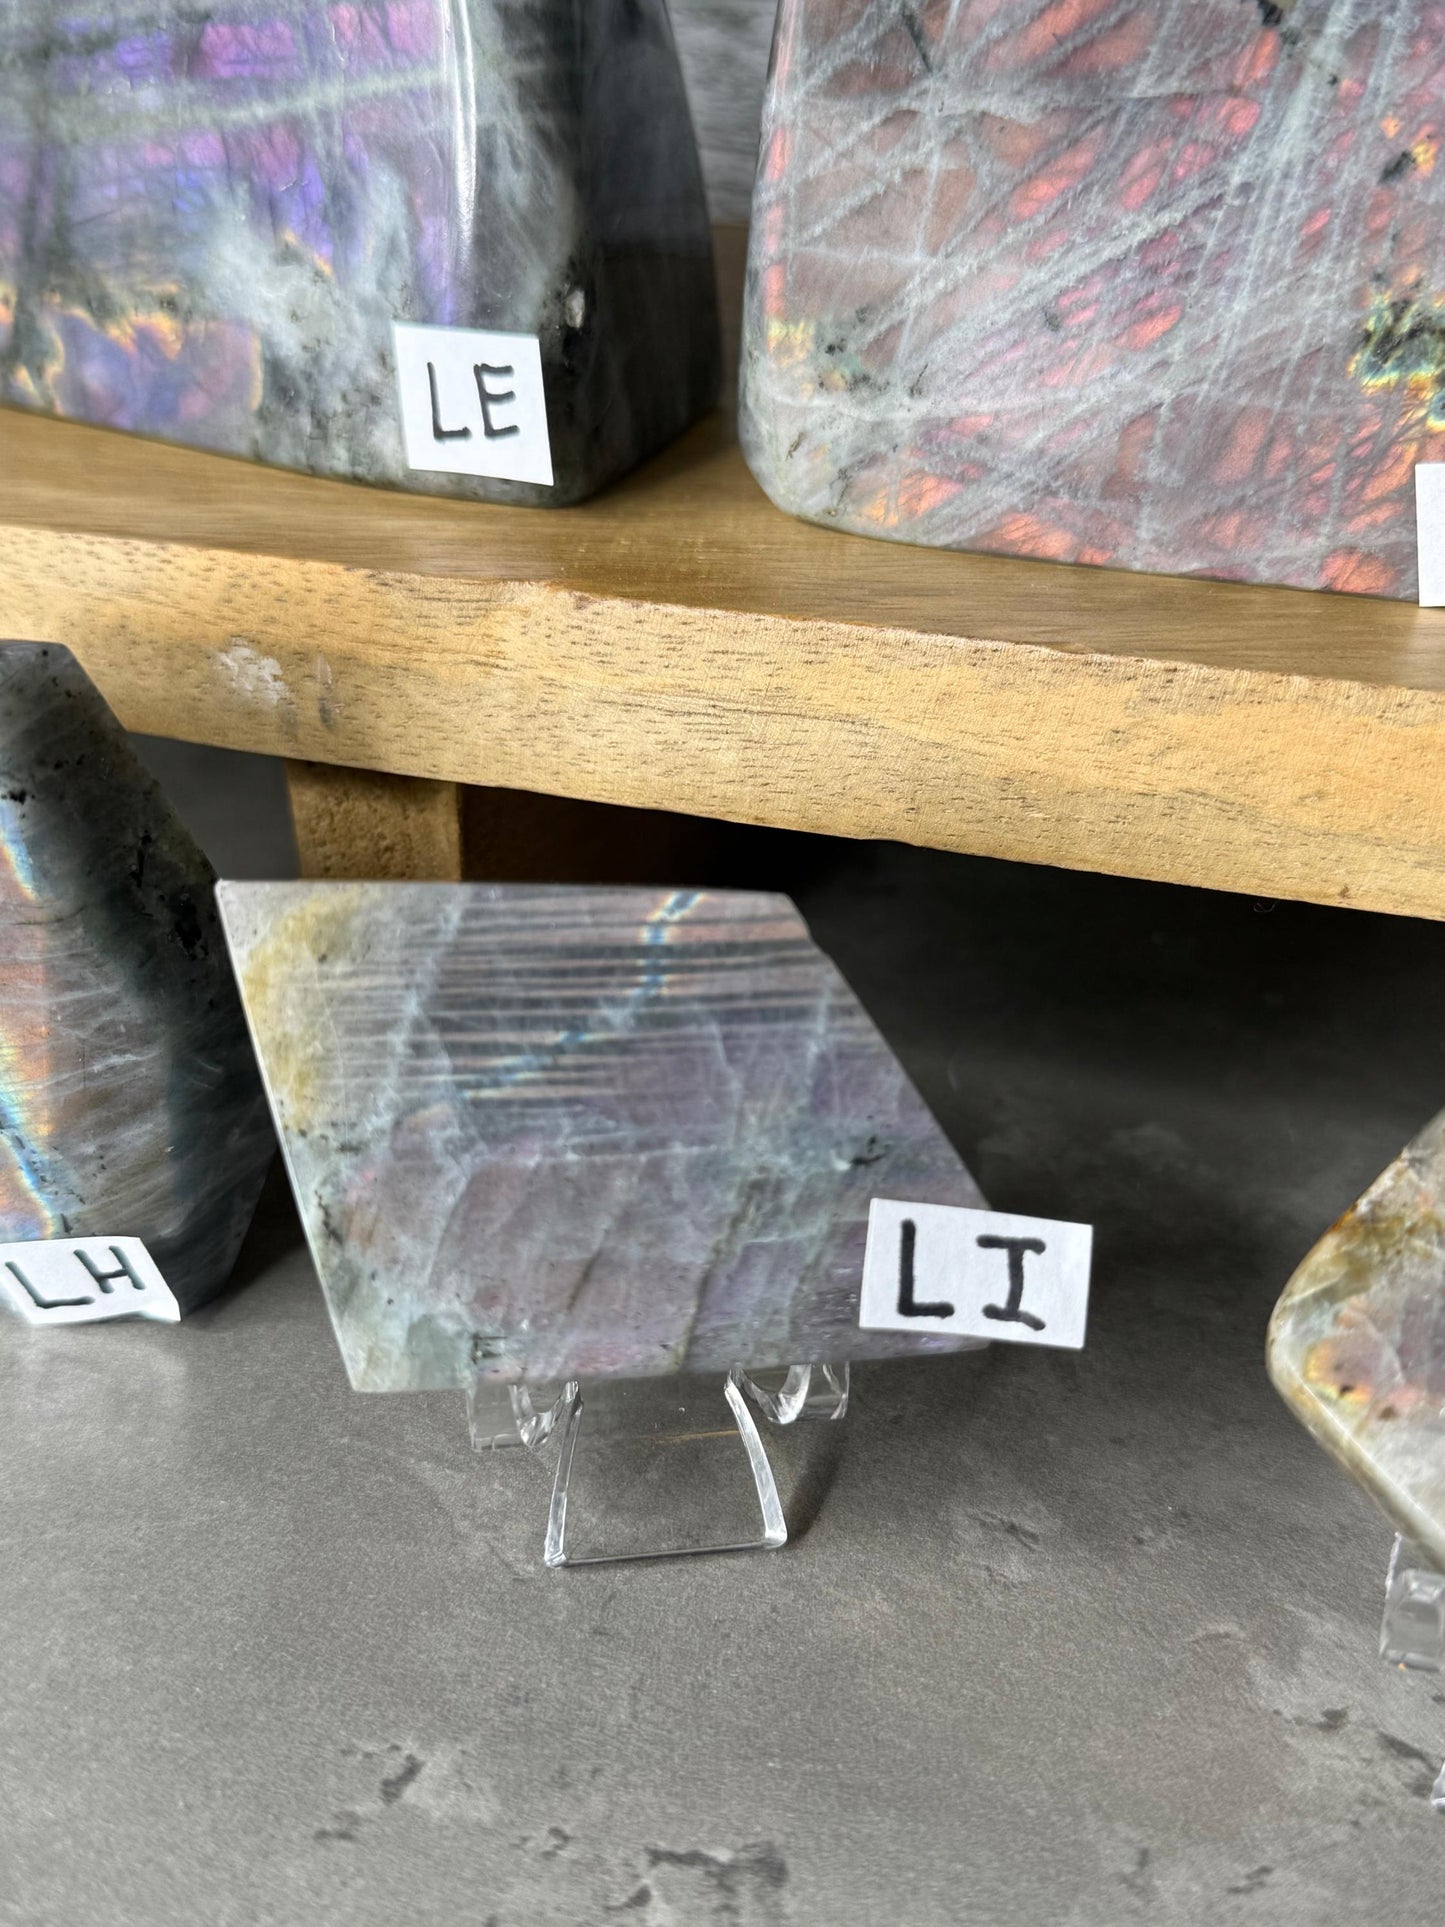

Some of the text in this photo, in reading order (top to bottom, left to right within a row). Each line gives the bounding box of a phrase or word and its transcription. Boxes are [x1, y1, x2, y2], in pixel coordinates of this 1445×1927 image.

[427, 361, 520, 442] LE
[5, 1245, 146, 1309] LH
[897, 1218, 1046, 1331] LI
